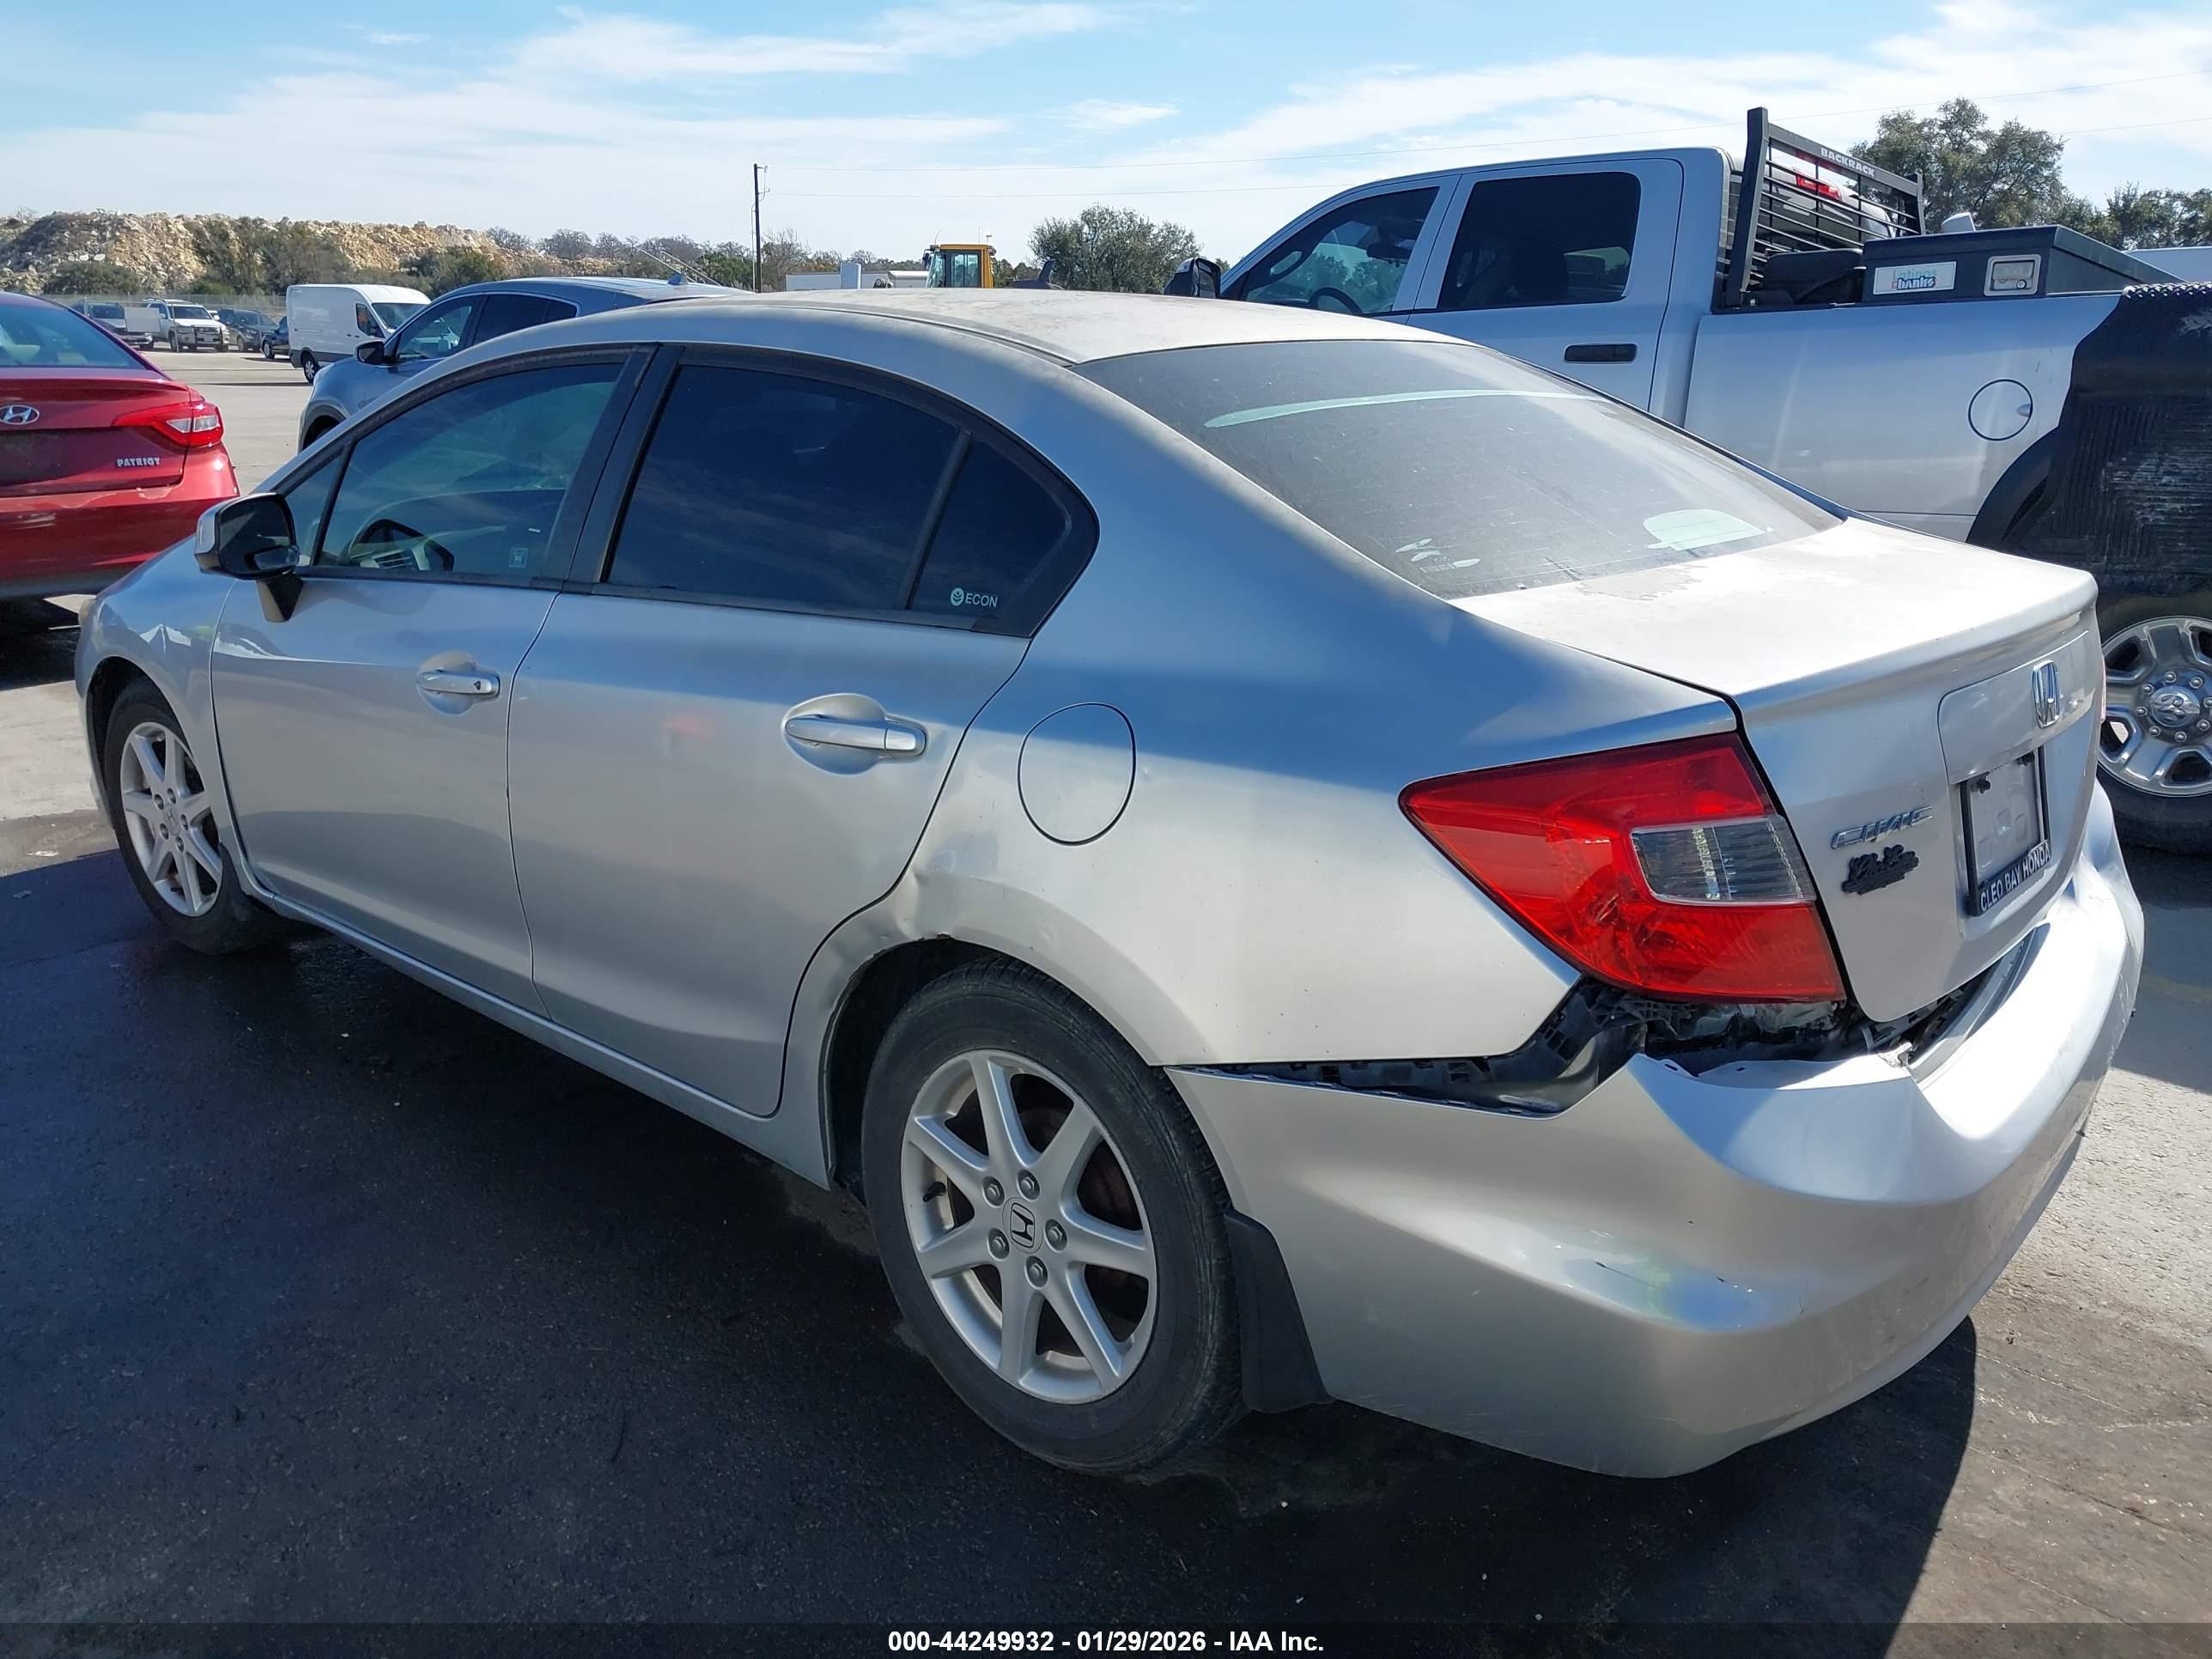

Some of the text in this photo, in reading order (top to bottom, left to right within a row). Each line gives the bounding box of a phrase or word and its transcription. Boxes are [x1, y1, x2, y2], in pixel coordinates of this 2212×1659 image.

[1820, 147, 1875, 178] BACKRACK
[1897, 275, 1936, 290] banks
[116, 457, 161, 468] PATRIOT
[965, 592, 998, 608] ECON
[1830, 805, 1934, 850] CIVIC
[1980, 842, 2051, 913] CLEO BAY HONDA
